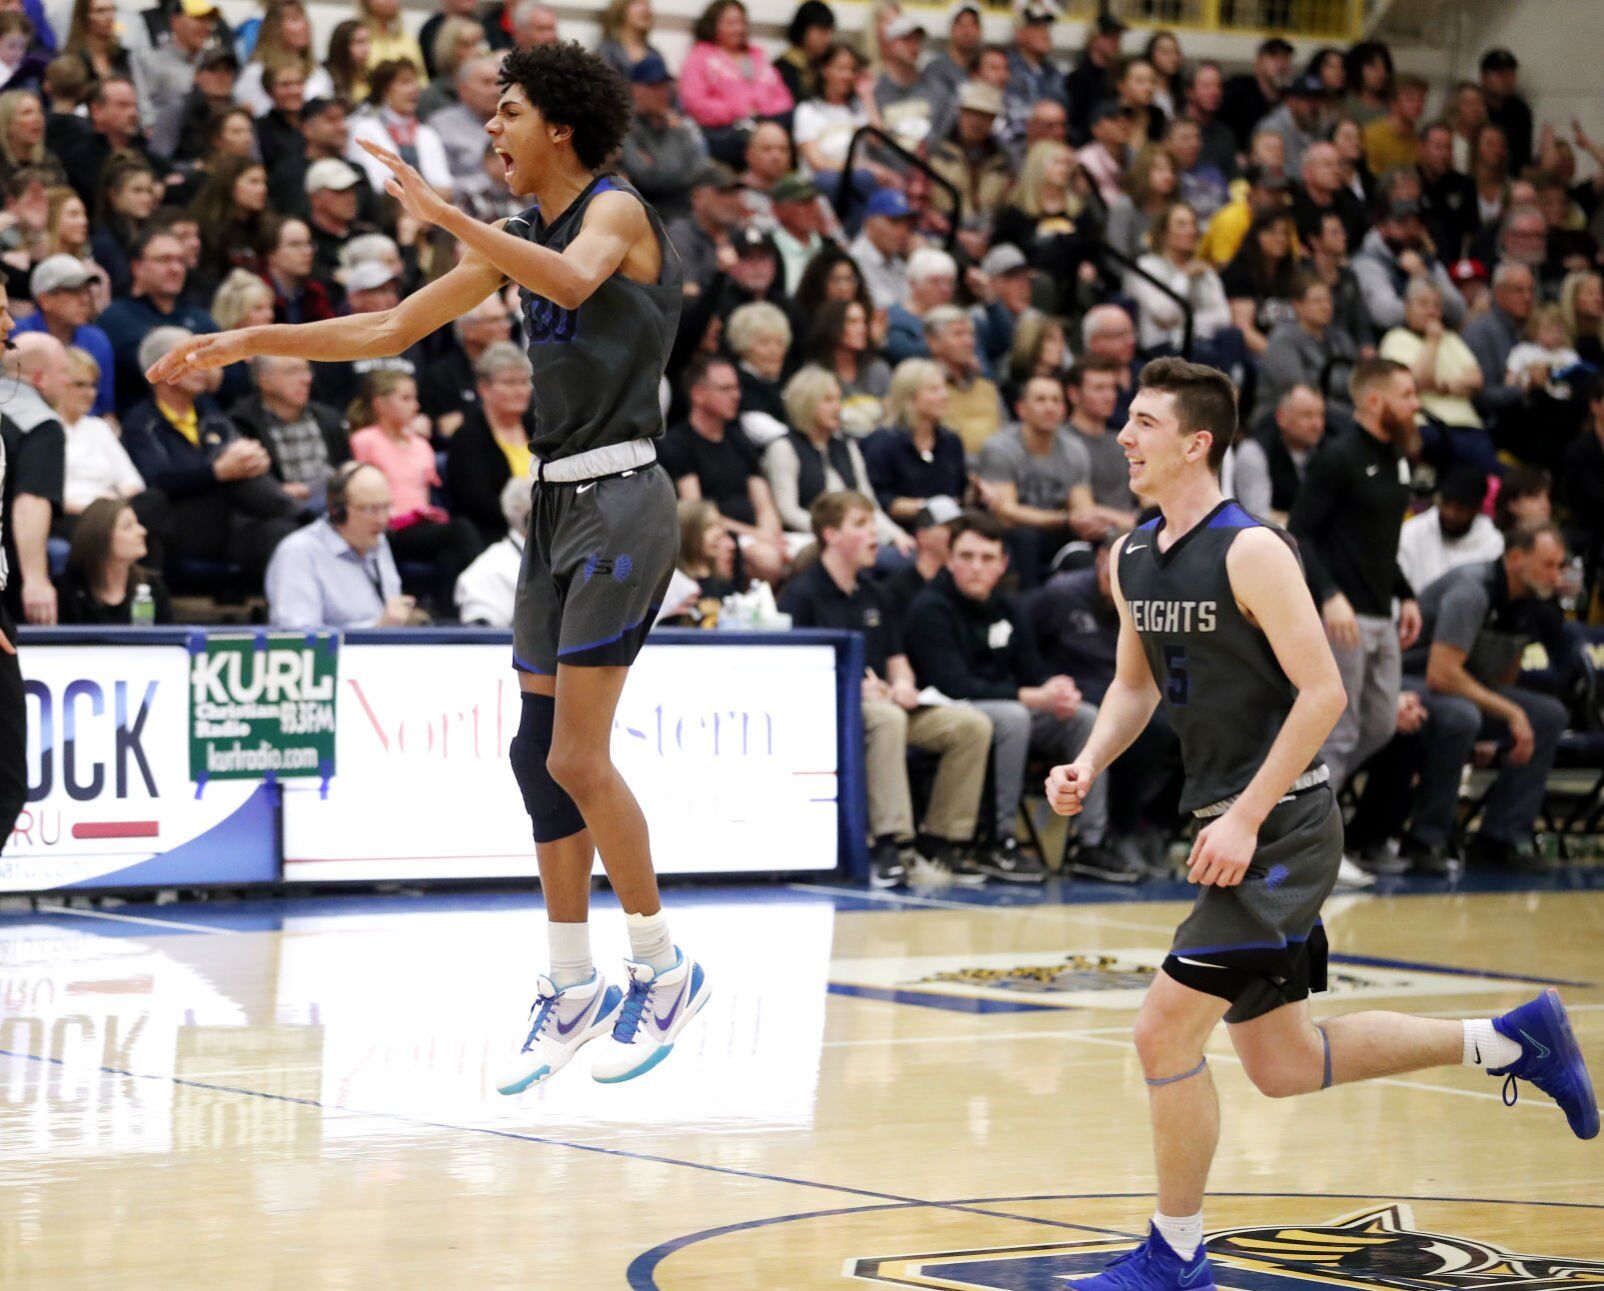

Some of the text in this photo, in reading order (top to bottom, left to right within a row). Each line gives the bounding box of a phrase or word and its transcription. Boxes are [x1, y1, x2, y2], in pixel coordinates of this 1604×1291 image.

[192, 650, 334, 703] KURL
[1163, 644, 1191, 706] 5
[207, 740, 318, 772] kurlradio.com
